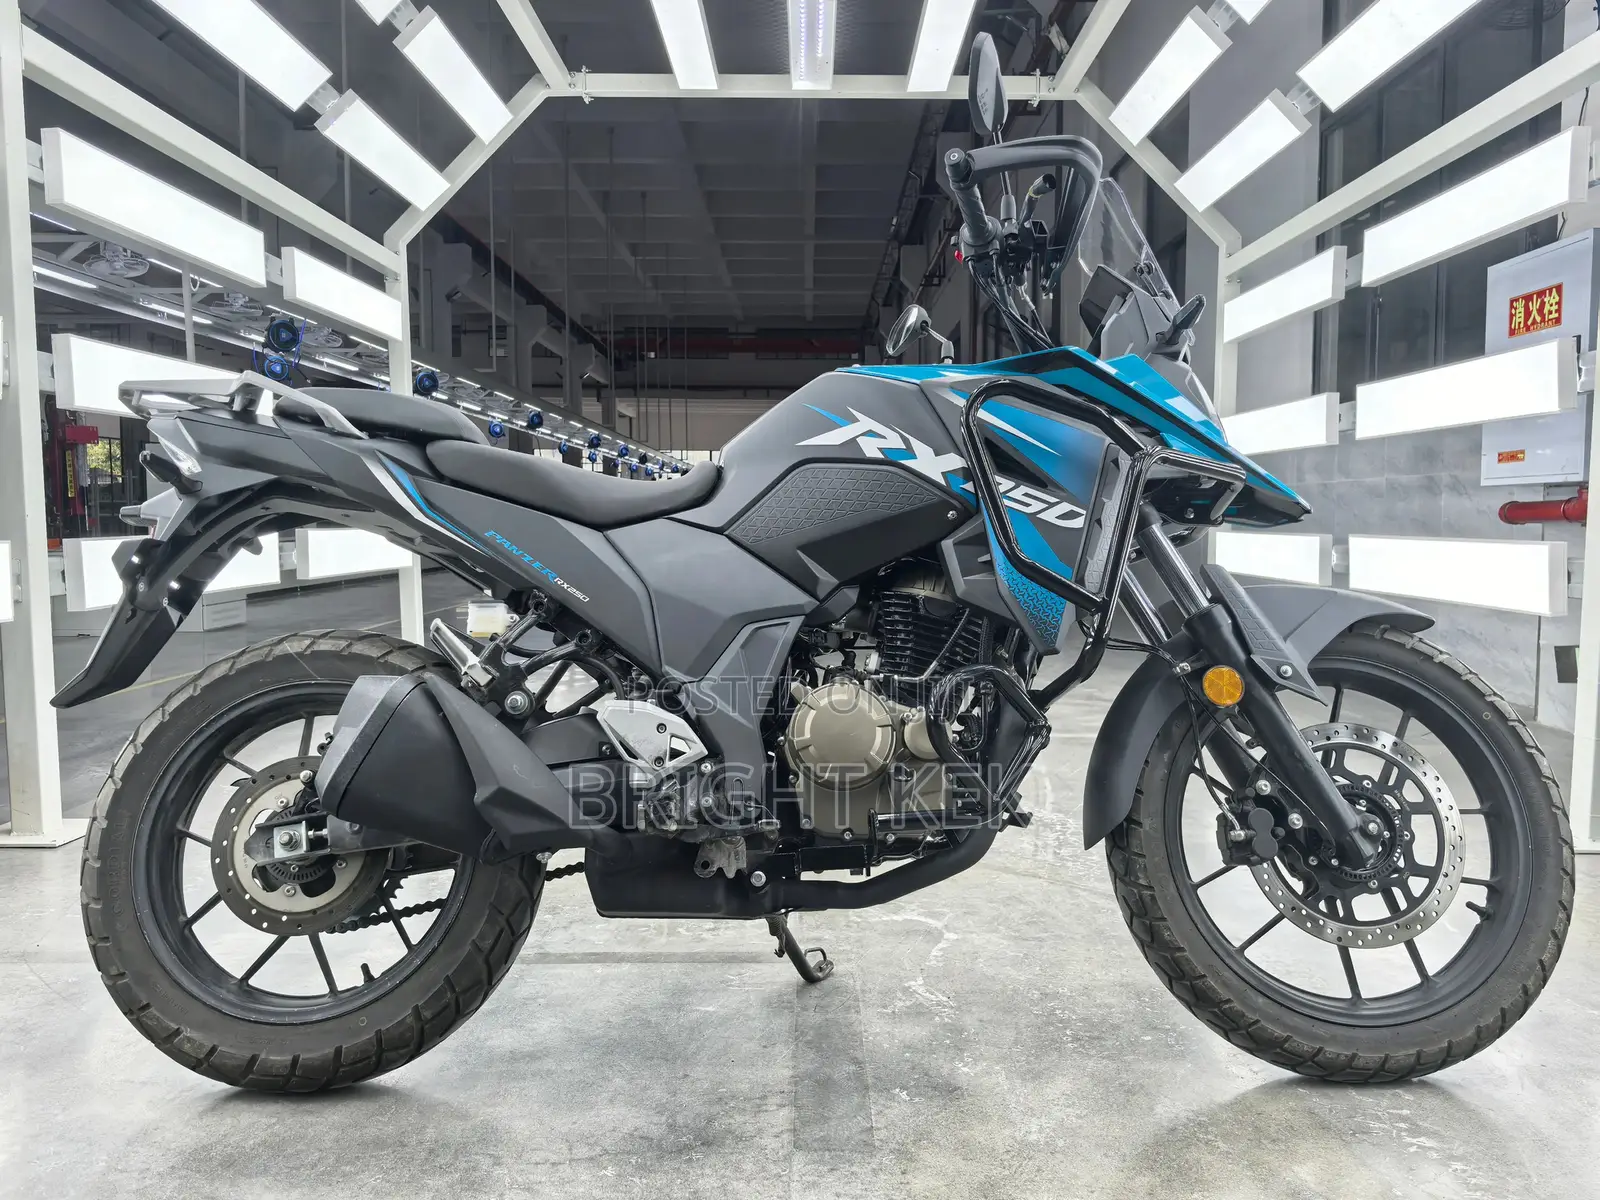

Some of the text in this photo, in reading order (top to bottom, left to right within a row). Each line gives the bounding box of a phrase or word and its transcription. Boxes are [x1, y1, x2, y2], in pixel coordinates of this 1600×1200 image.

[1511, 288, 1559, 329] 消火栓
[484, 529, 590, 603] PANZER RX250
